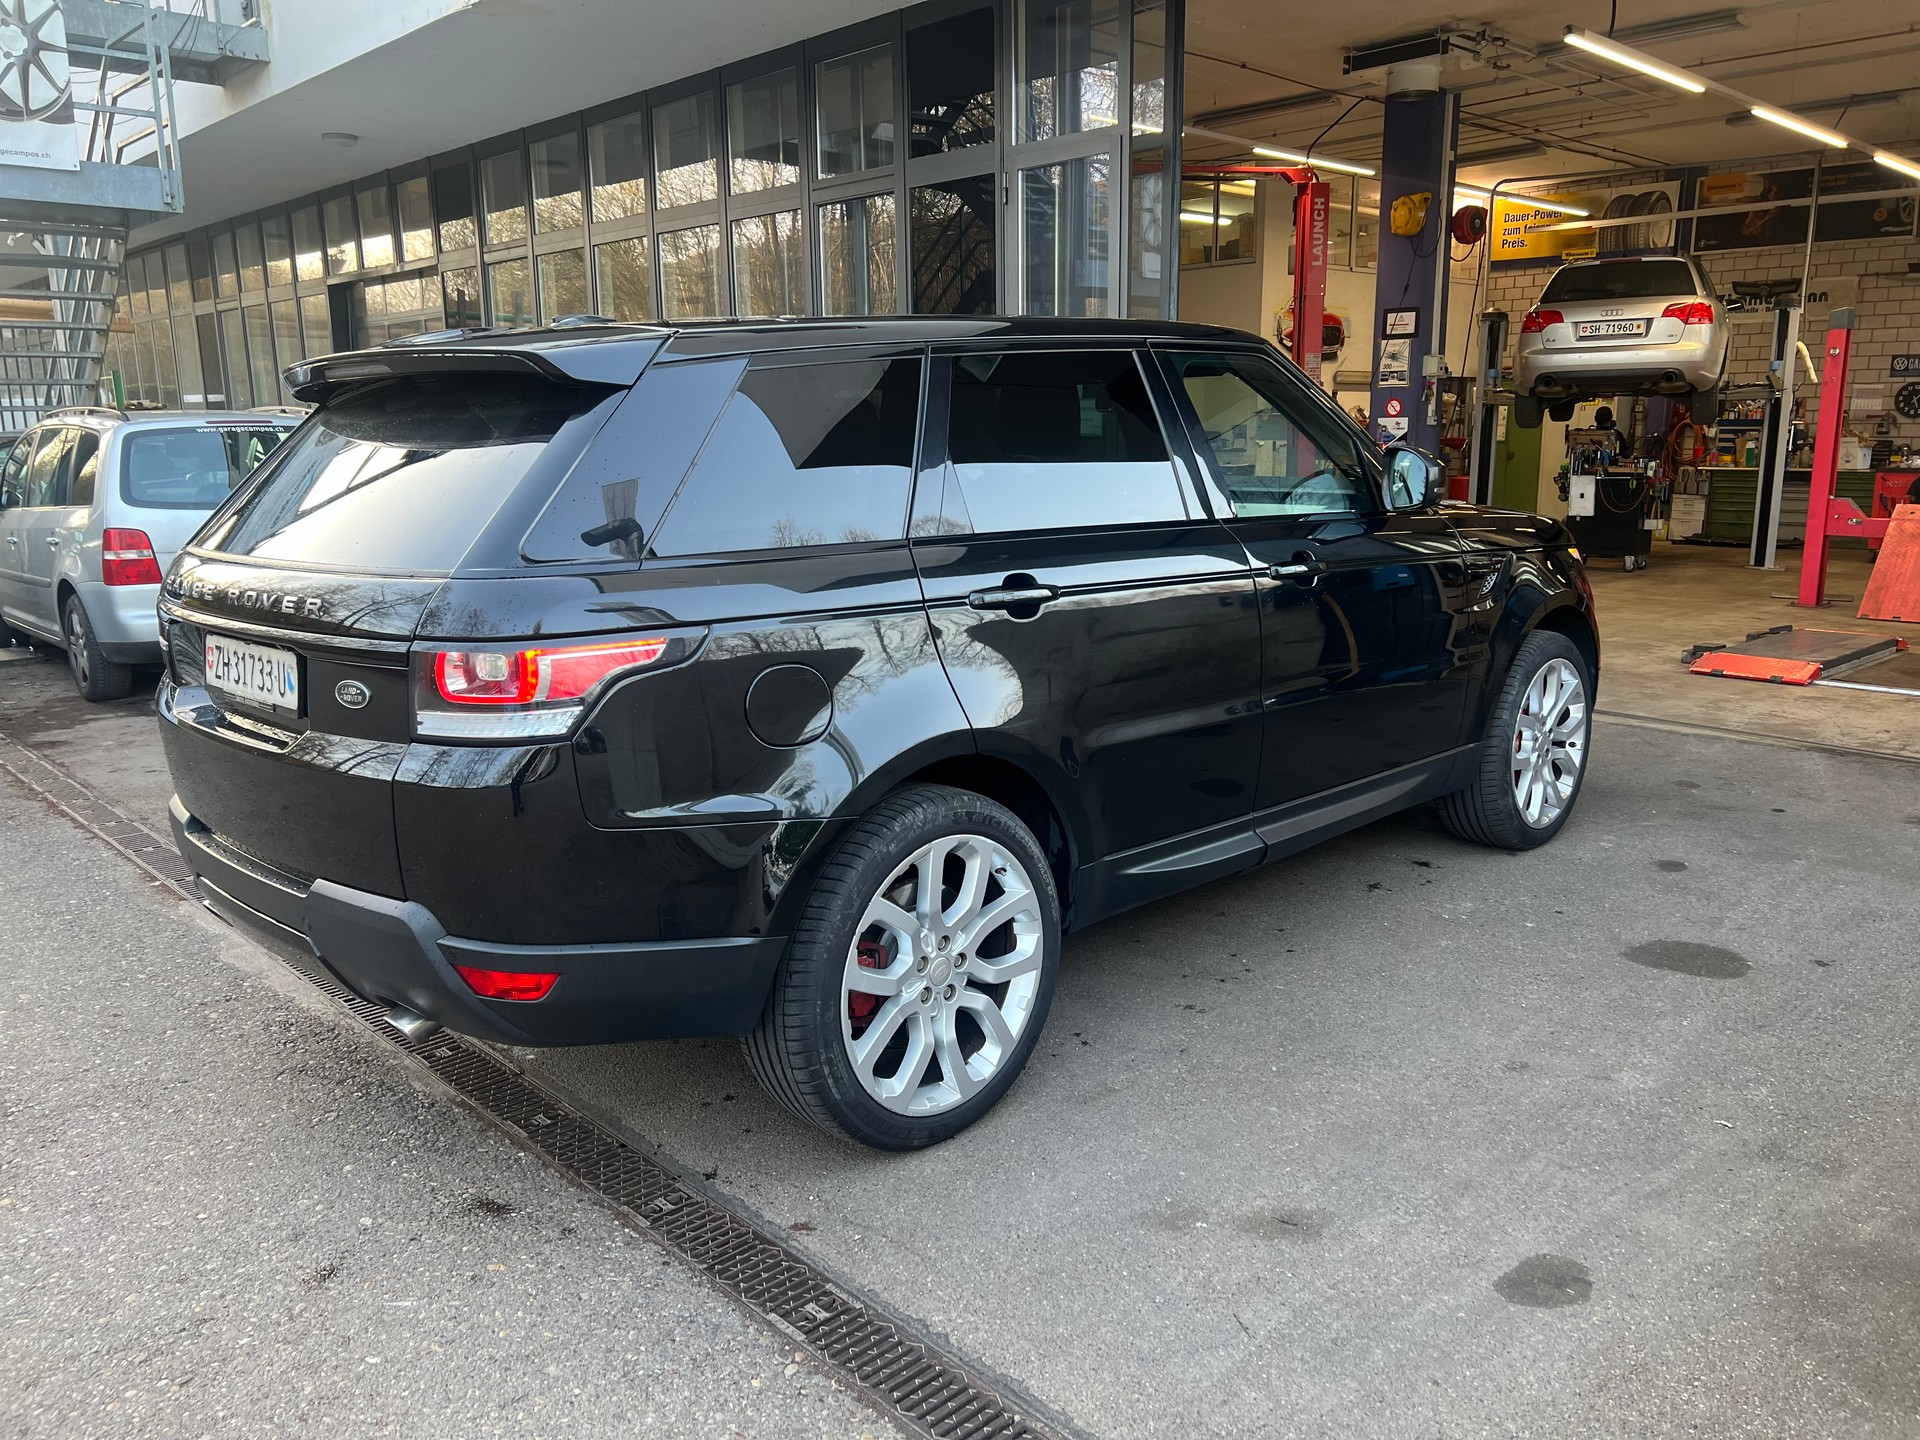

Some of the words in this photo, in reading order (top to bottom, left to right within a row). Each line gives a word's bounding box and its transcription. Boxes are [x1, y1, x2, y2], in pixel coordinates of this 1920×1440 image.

[1312, 197, 1325, 266] LAUNCH
[1502, 227, 1521, 236] zum
[1502, 239, 1528, 249] Preis.
[1909, 357, 1920, 369] GA
[166, 575, 217, 601] RANGE
[227, 588, 324, 617] ROVER
